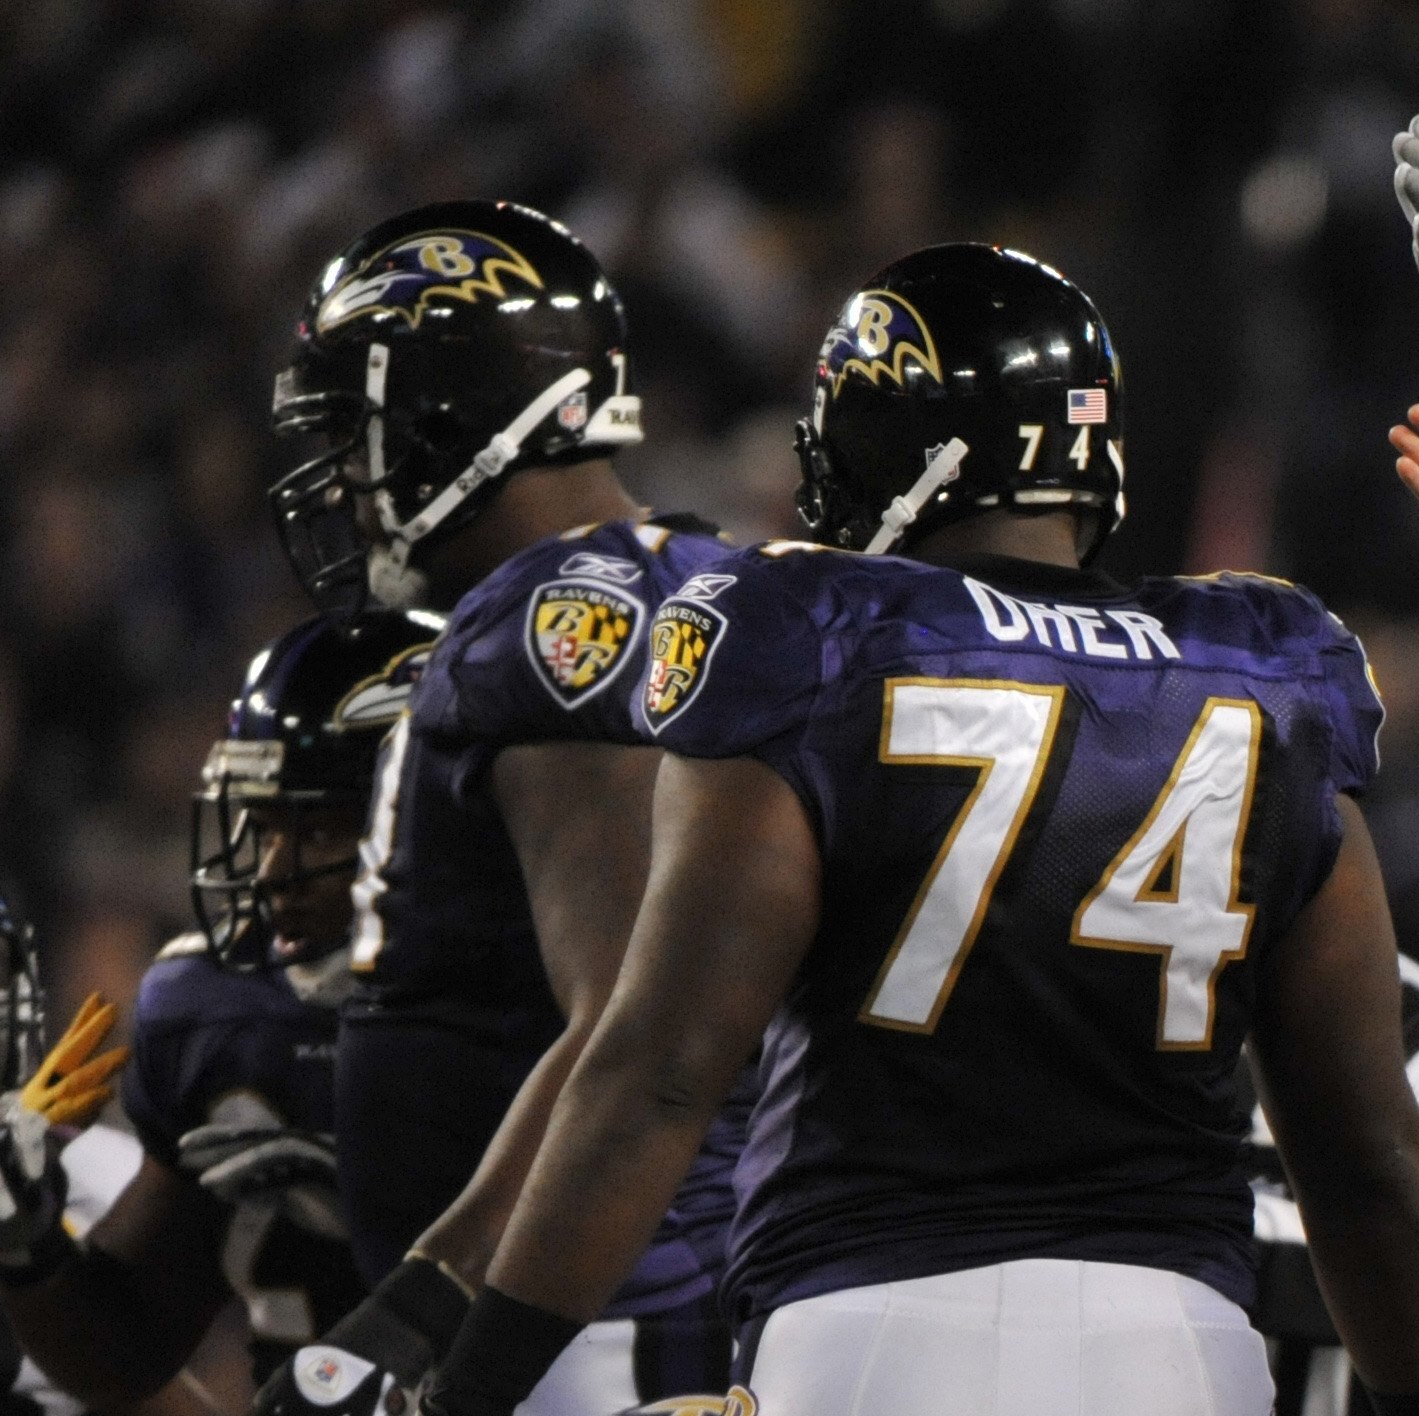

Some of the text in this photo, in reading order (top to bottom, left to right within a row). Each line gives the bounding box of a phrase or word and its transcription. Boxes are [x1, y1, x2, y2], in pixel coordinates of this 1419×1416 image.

[544, 588, 632, 616] RAVENS
[657, 605, 713, 631] RAVENS
[962, 575, 1182, 660] OHER
[857, 677, 1263, 1051] 74
